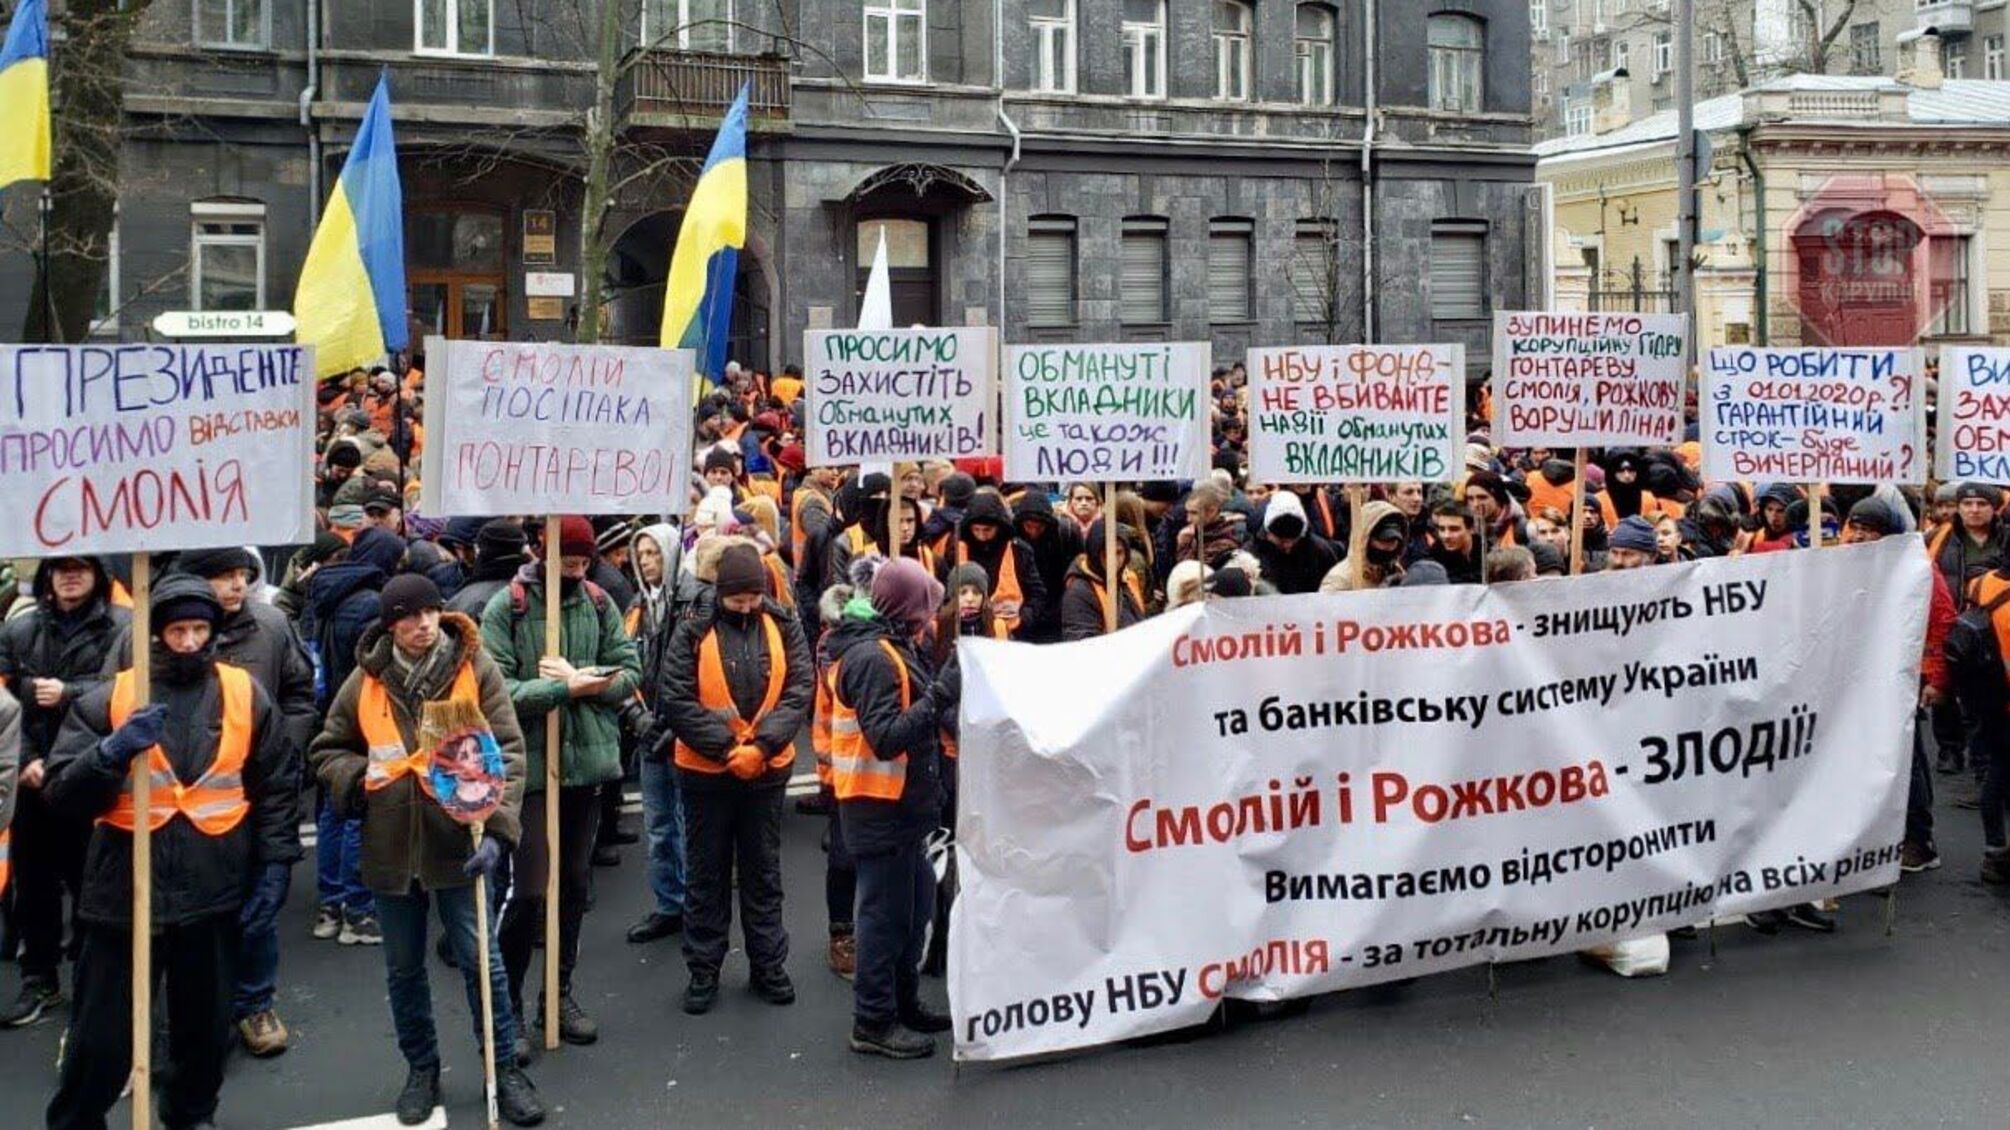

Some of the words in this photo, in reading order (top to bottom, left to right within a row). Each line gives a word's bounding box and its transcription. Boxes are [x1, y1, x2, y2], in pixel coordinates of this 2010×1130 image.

[188, 316, 240, 329] bistro
[247, 315, 263, 328] 14
[1506, 315, 1643, 337] ЗУПИНЕМО
[826, 333, 958, 363] ПРОСИМО
[1263, 352, 1322, 383] НБУ
[1711, 350, 1757, 376] ЩО
[1765, 348, 1894, 380] РОБИТИ
[15, 346, 305, 418] ПРЕЗИДЕНТЕ
[1262, 386, 1302, 412] НЕ
[1313, 382, 1451, 414] ВБИВАЙТЕ
[480, 386, 650, 427] ПОСІПАКА
[1024, 385, 1196, 421] ВКЛАДНИКИ
[1, 415, 176, 474] ПРОСИМО
[1018, 422, 1050, 442] це
[34, 458, 248, 547] СМОЛІЯ
[1172, 623, 1302, 668] Смолій
[1315, 622, 1325, 655] і
[1337, 618, 1510, 653] Рожкова
[1533, 596, 1693, 638] знищують
[1703, 580, 1767, 617] НБУ
[1214, 708, 1248, 737] та
[1259, 690, 1489, 732] банківську
[1497, 673, 1617, 715] систему
[1624, 653, 1758, 698] України
[1126, 775, 1320, 853] Смолій
[1337, 771, 1351, 823] і
[1371, 760, 1609, 823] Рожкова
[1640, 704, 1817, 784] ЗЛОДІЇ!
[1265, 863, 1491, 903] Вимагаємо
[1502, 818, 1716, 886] відсторонити
[967, 990, 1095, 1042] голову
[1106, 968, 1187, 1013] НБУ
[1363, 943, 1403, 969] за
[1413, 914, 1570, 960] тотальну
[1576, 881, 1714, 938] корупцію
[1717, 870, 1752, 898] на
[1762, 855, 1827, 890] всіх
